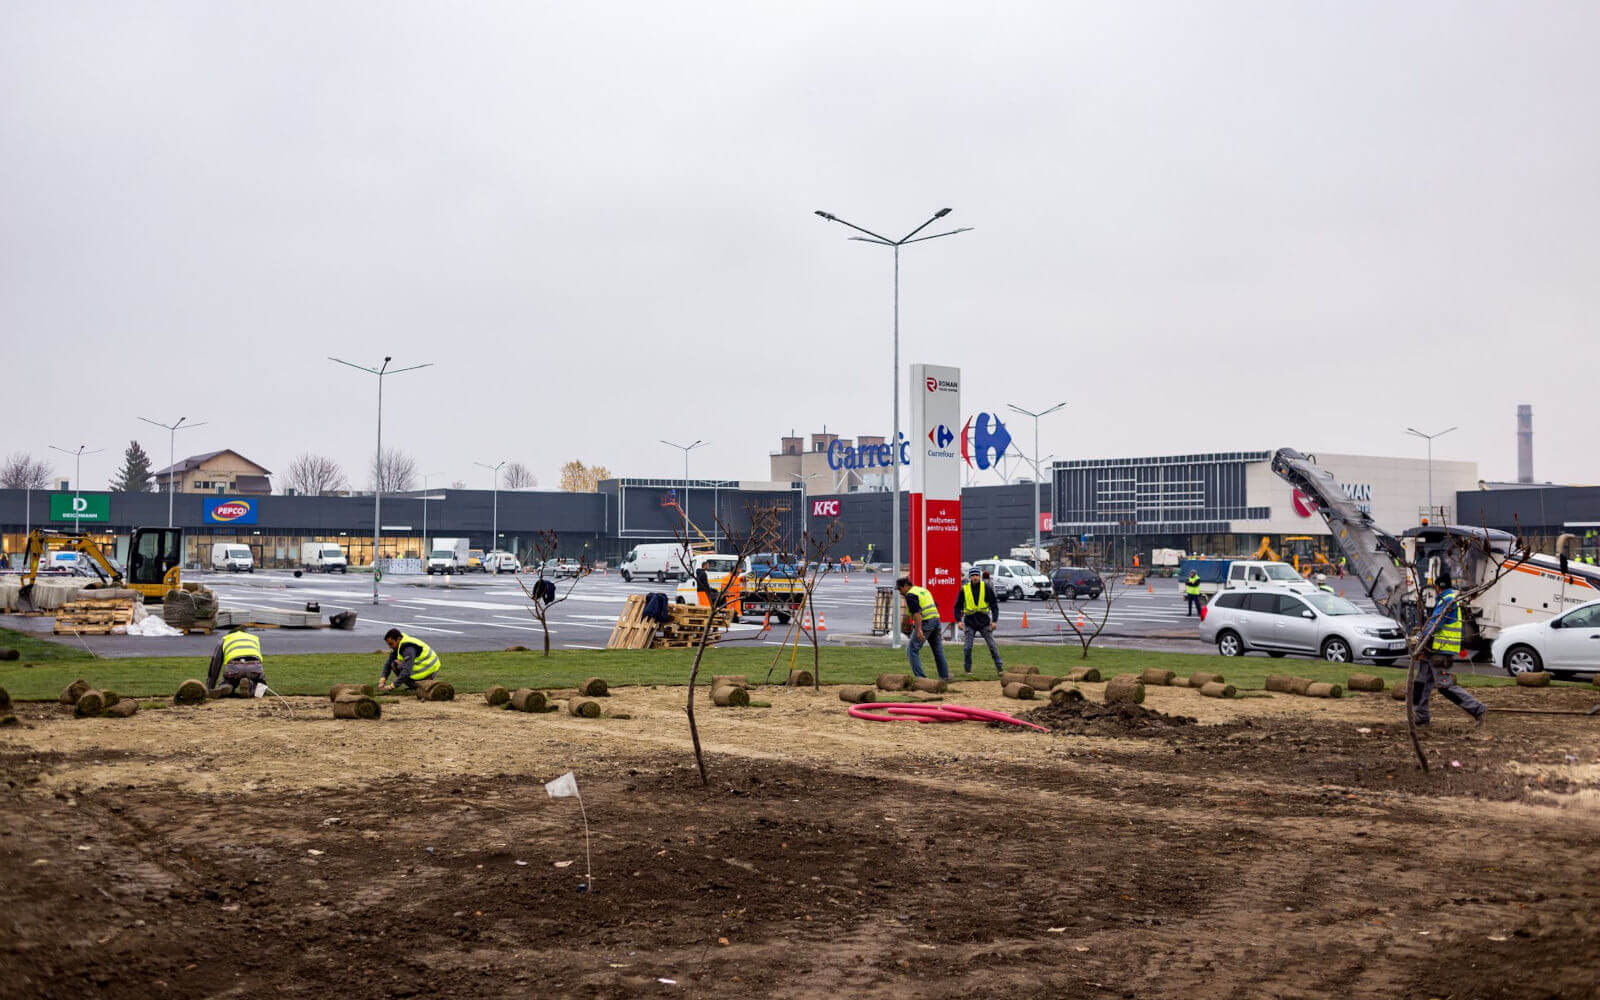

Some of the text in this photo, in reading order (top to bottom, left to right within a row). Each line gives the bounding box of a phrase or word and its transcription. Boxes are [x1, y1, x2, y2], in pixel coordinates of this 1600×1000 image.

[938, 380, 958, 388] ROMAN
[927, 450, 955, 458] Carrefour
[73, 497, 87, 511] D
[813, 501, 839, 516] KFC
[217, 506, 244, 515] PEPCO
[934, 567, 949, 576] Bine
[938, 577, 955, 585] venit!
